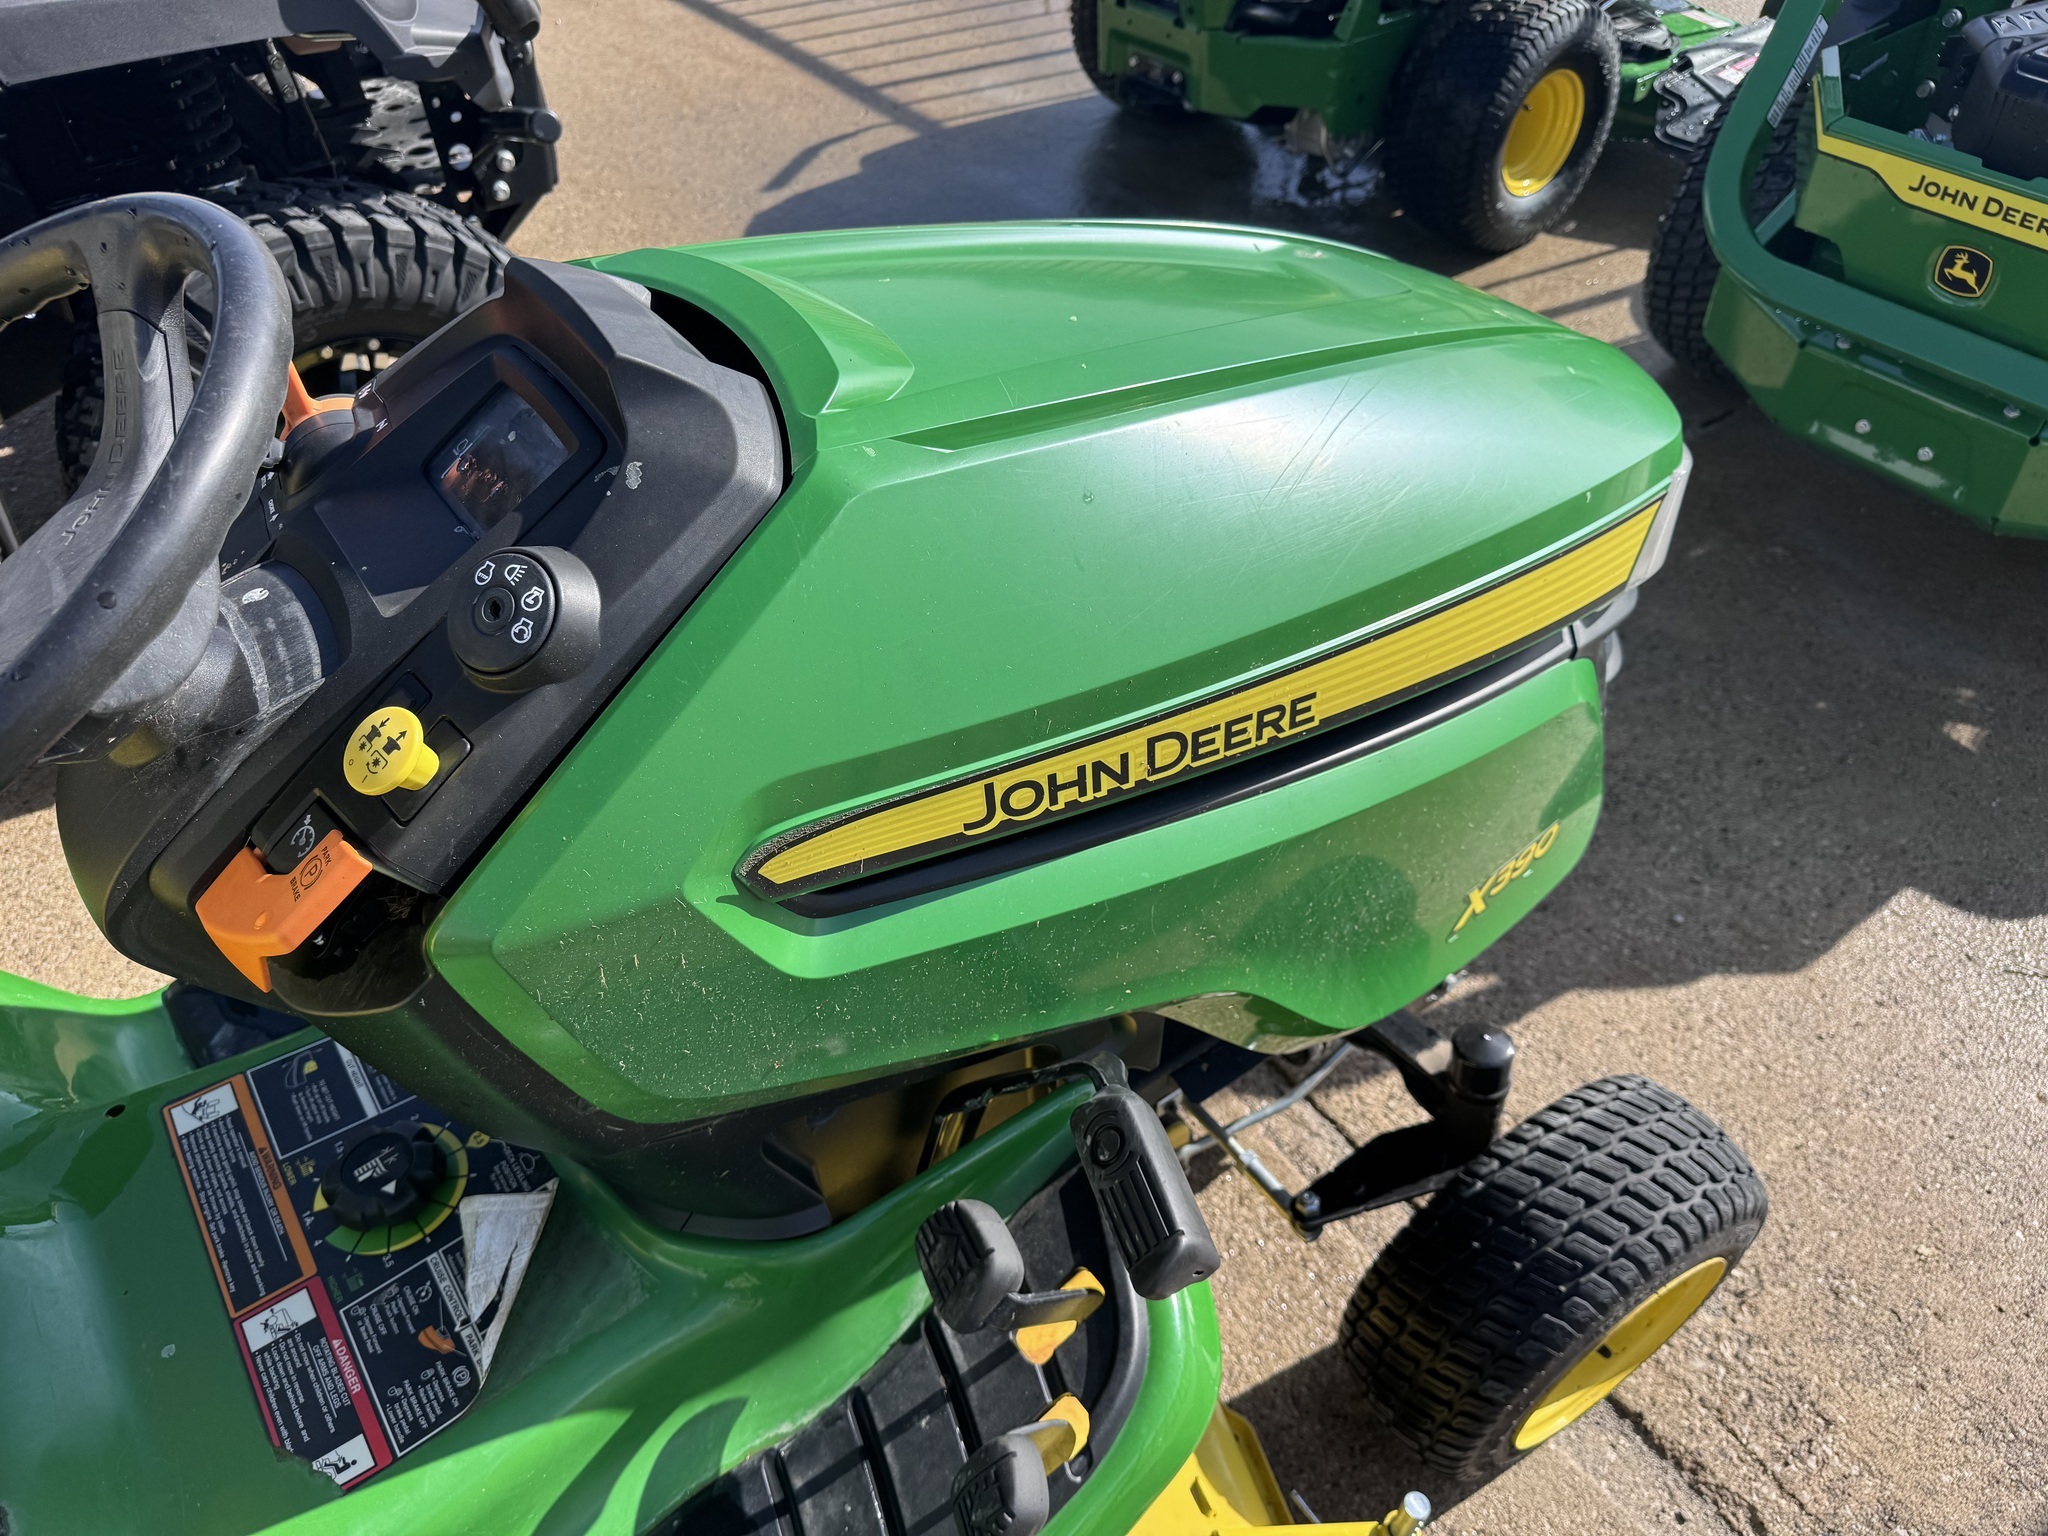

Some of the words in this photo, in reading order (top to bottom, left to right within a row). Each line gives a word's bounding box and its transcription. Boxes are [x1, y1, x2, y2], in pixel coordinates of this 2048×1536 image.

[1908, 175, 1979, 211] JOHN
[61, 473, 117, 545] JOHN
[109, 349, 127, 464] DEERE
[962, 752, 1131, 834] JOHN
[1145, 691, 1320, 778] DEERE
[320, 846, 332, 867] PARK
[289, 877, 301, 902] BRAKE
[1452, 822, 1560, 936] X390
[202, 1127, 211, 1139] Keep
[212, 1128, 222, 1146] machine
[181, 1138, 189, 1151] When
[206, 1139, 215, 1153] safety
[218, 1146, 227, 1159] stops
[184, 1151, 195, 1168] leaving
[212, 1153, 222, 1170] devices
[222, 1159, 231, 1173] going
[249, 1150, 259, 1166] AVOID
[196, 1130, 204, 1142] Drive
[205, 1159, 213, 1171] down
[219, 1198, 228, 1214] across
[254, 1165, 267, 1188] SERIOUS
[262, 1153, 281, 1189] WARNING
[282, 1161, 297, 1185] LOWER
[189, 1134, 199, 1152] Remove
[194, 1153, 204, 1170] objects
[209, 1195, 219, 1212] thrown
[217, 1219, 226, 1233] blade
[232, 1188, 240, 1199] stop
[236, 1199, 245, 1213] blade
[263, 1188, 274, 1207] INJURY
[201, 1203, 212, 1220] engine
[270, 1207, 277, 1216] OR
[234, 1219, 247, 1243] switches)
[245, 1223, 253, 1234] back
[273, 1216, 284, 1235] DEATH
[211, 1231, 219, 1243] park
[249, 1235, 258, 1249] down
[215, 1242, 225, 1258] brake
[244, 1248, 254, 1262] place
[253, 1250, 264, 1267] slowly
[250, 1263, 258, 1273] and
[227, 1282, 236, 1292] key
[253, 1274, 266, 1296] working
[430, 1256, 446, 1283] CRUISE
[443, 1284, 464, 1320] CONTROL
[403, 1285, 415, 1305] CRUISE
[411, 1305, 419, 1315] ON
[369, 1303, 381, 1323] CRUISE
[378, 1323, 386, 1335] OFF
[384, 1304, 392, 1317] Push
[389, 1317, 399, 1334] button
[465, 1333, 480, 1356] PARK
[254, 1355, 265, 1371] Never
[262, 1351, 272, 1366] while
[290, 1347, 301, 1367] around
[259, 1372, 269, 1387] carry
[266, 1366, 281, 1390] backing
[278, 1342, 286, 1351] Do
[285, 1361, 293, 1374] mow
[293, 1382, 304, 1403] reverse
[312, 1344, 321, 1357] OFF
[317, 1357, 329, 1376] ARMS
[324, 1376, 334, 1390] AND
[329, 1390, 341, 1408] LEGS
[319, 1337, 335, 1367] ROTATING
[330, 1367, 345, 1392] BLADES
[340, 1392, 350, 1406] CUT
[335, 1346, 361, 1393] DANGER
[294, 1333, 302, 1341] Do
[301, 1352, 309, 1365] mow
[307, 1366, 316, 1382] when
[313, 1382, 326, 1405] children
[324, 1413, 335, 1432] others
[432, 1380, 444, 1402] Depress
[435, 1360, 445, 1376] PARK
[442, 1377, 455, 1397] BRAKE
[451, 1397, 459, 1407] ON
[265, 1386, 278, 1409] children
[271, 1346, 280, 1361] Look
[276, 1361, 286, 1377] down
[282, 1377, 290, 1388] and
[286, 1389, 297, 1408] behind
[293, 1408, 304, 1428] before
[300, 1428, 309, 1442] and
[403, 1379, 413, 1396] PARK
[409, 1395, 422, 1416] BRAKE
[418, 1416, 428, 1429] OFF
[418, 1388, 428, 1403] Raise
[425, 1403, 436, 1422] handle
[425, 1383, 435, 1399] brake
[431, 1399, 442, 1414] pedal
[274, 1410, 282, 1425] even
[394, 1402, 403, 1418] brake
[399, 1418, 411, 1434] pedal
[400, 1398, 413, 1421] Depress
[279, 1425, 288, 1438] with
[386, 1406, 396, 1423] Lower
[393, 1423, 405, 1443] handle
[283, 1438, 294, 1453] bla
